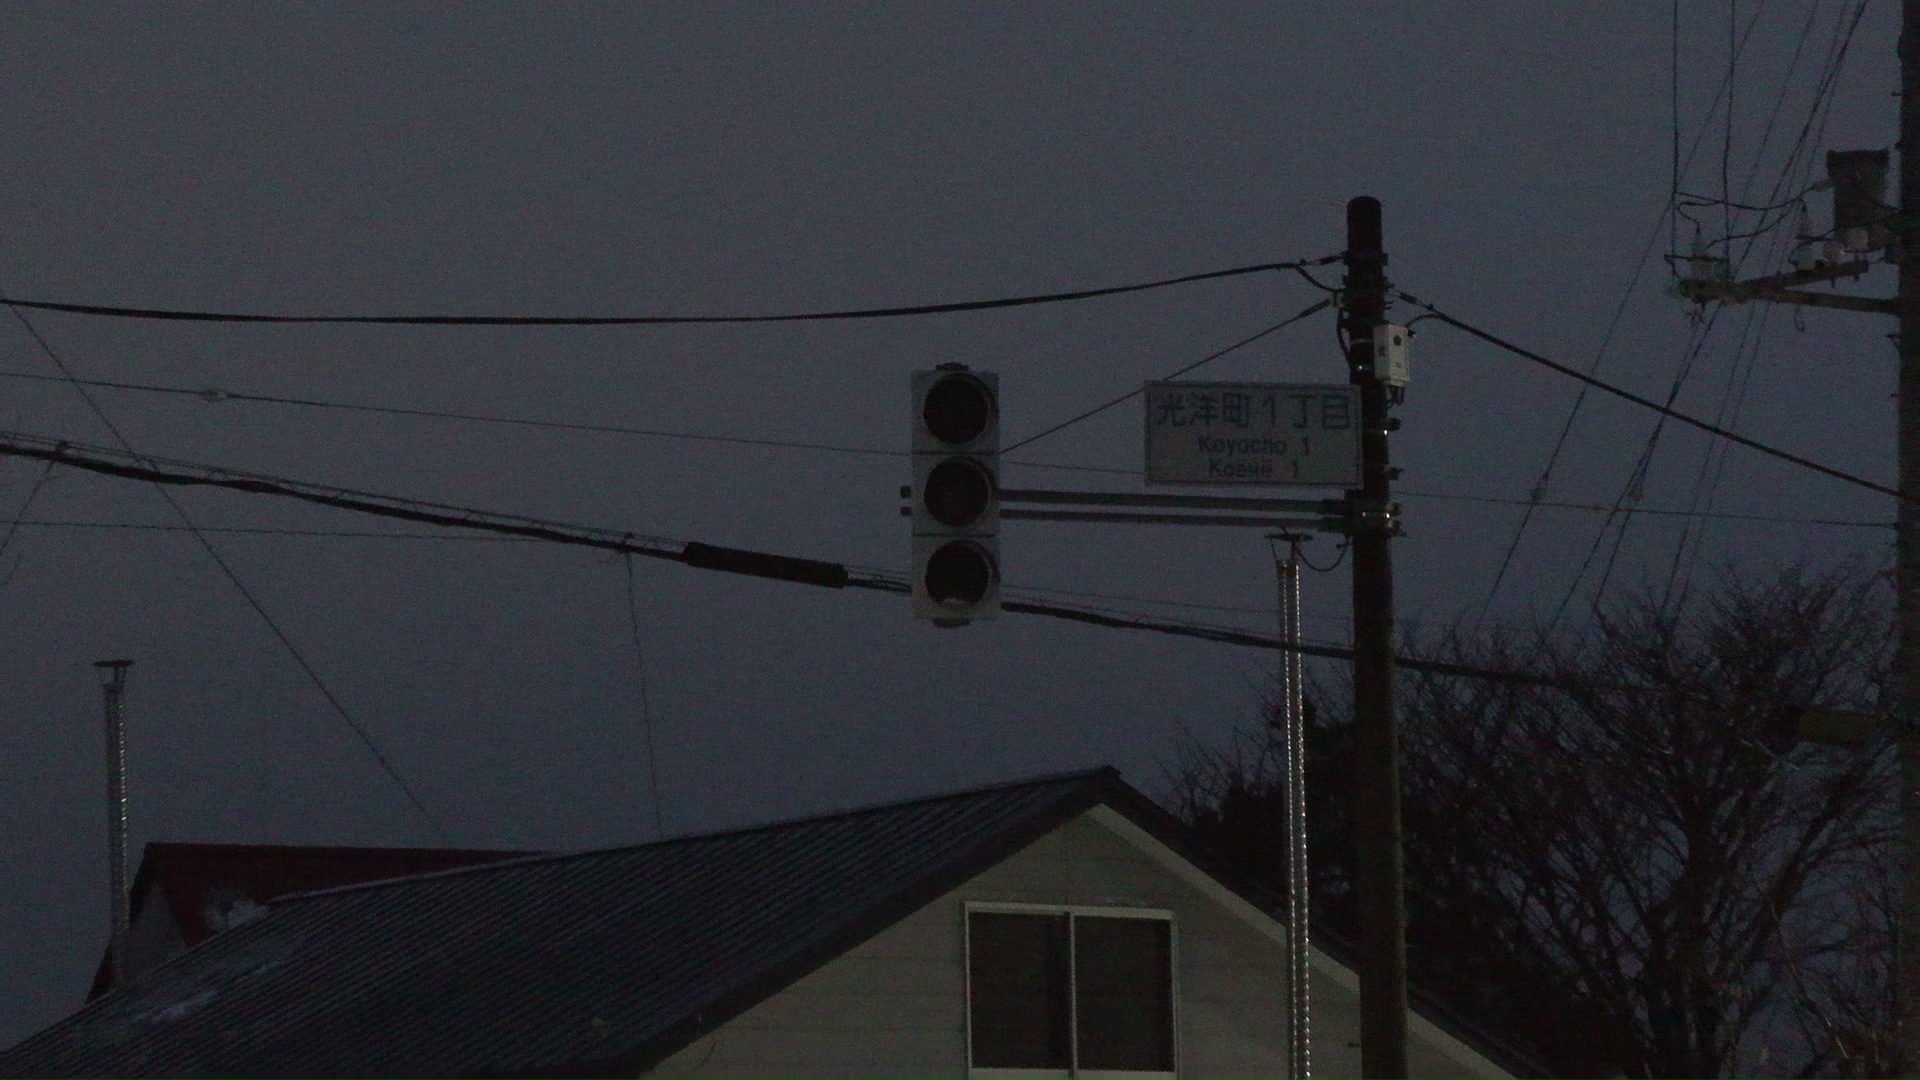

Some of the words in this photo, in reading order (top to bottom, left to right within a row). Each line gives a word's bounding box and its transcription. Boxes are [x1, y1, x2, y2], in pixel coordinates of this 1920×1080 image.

[1155, 391, 1350, 430] 光洋町1丁目
[1198, 436, 1288, 457] Koyocho
[1301, 435, 1310, 455] 1
[1291, 460, 1299, 478] 1
